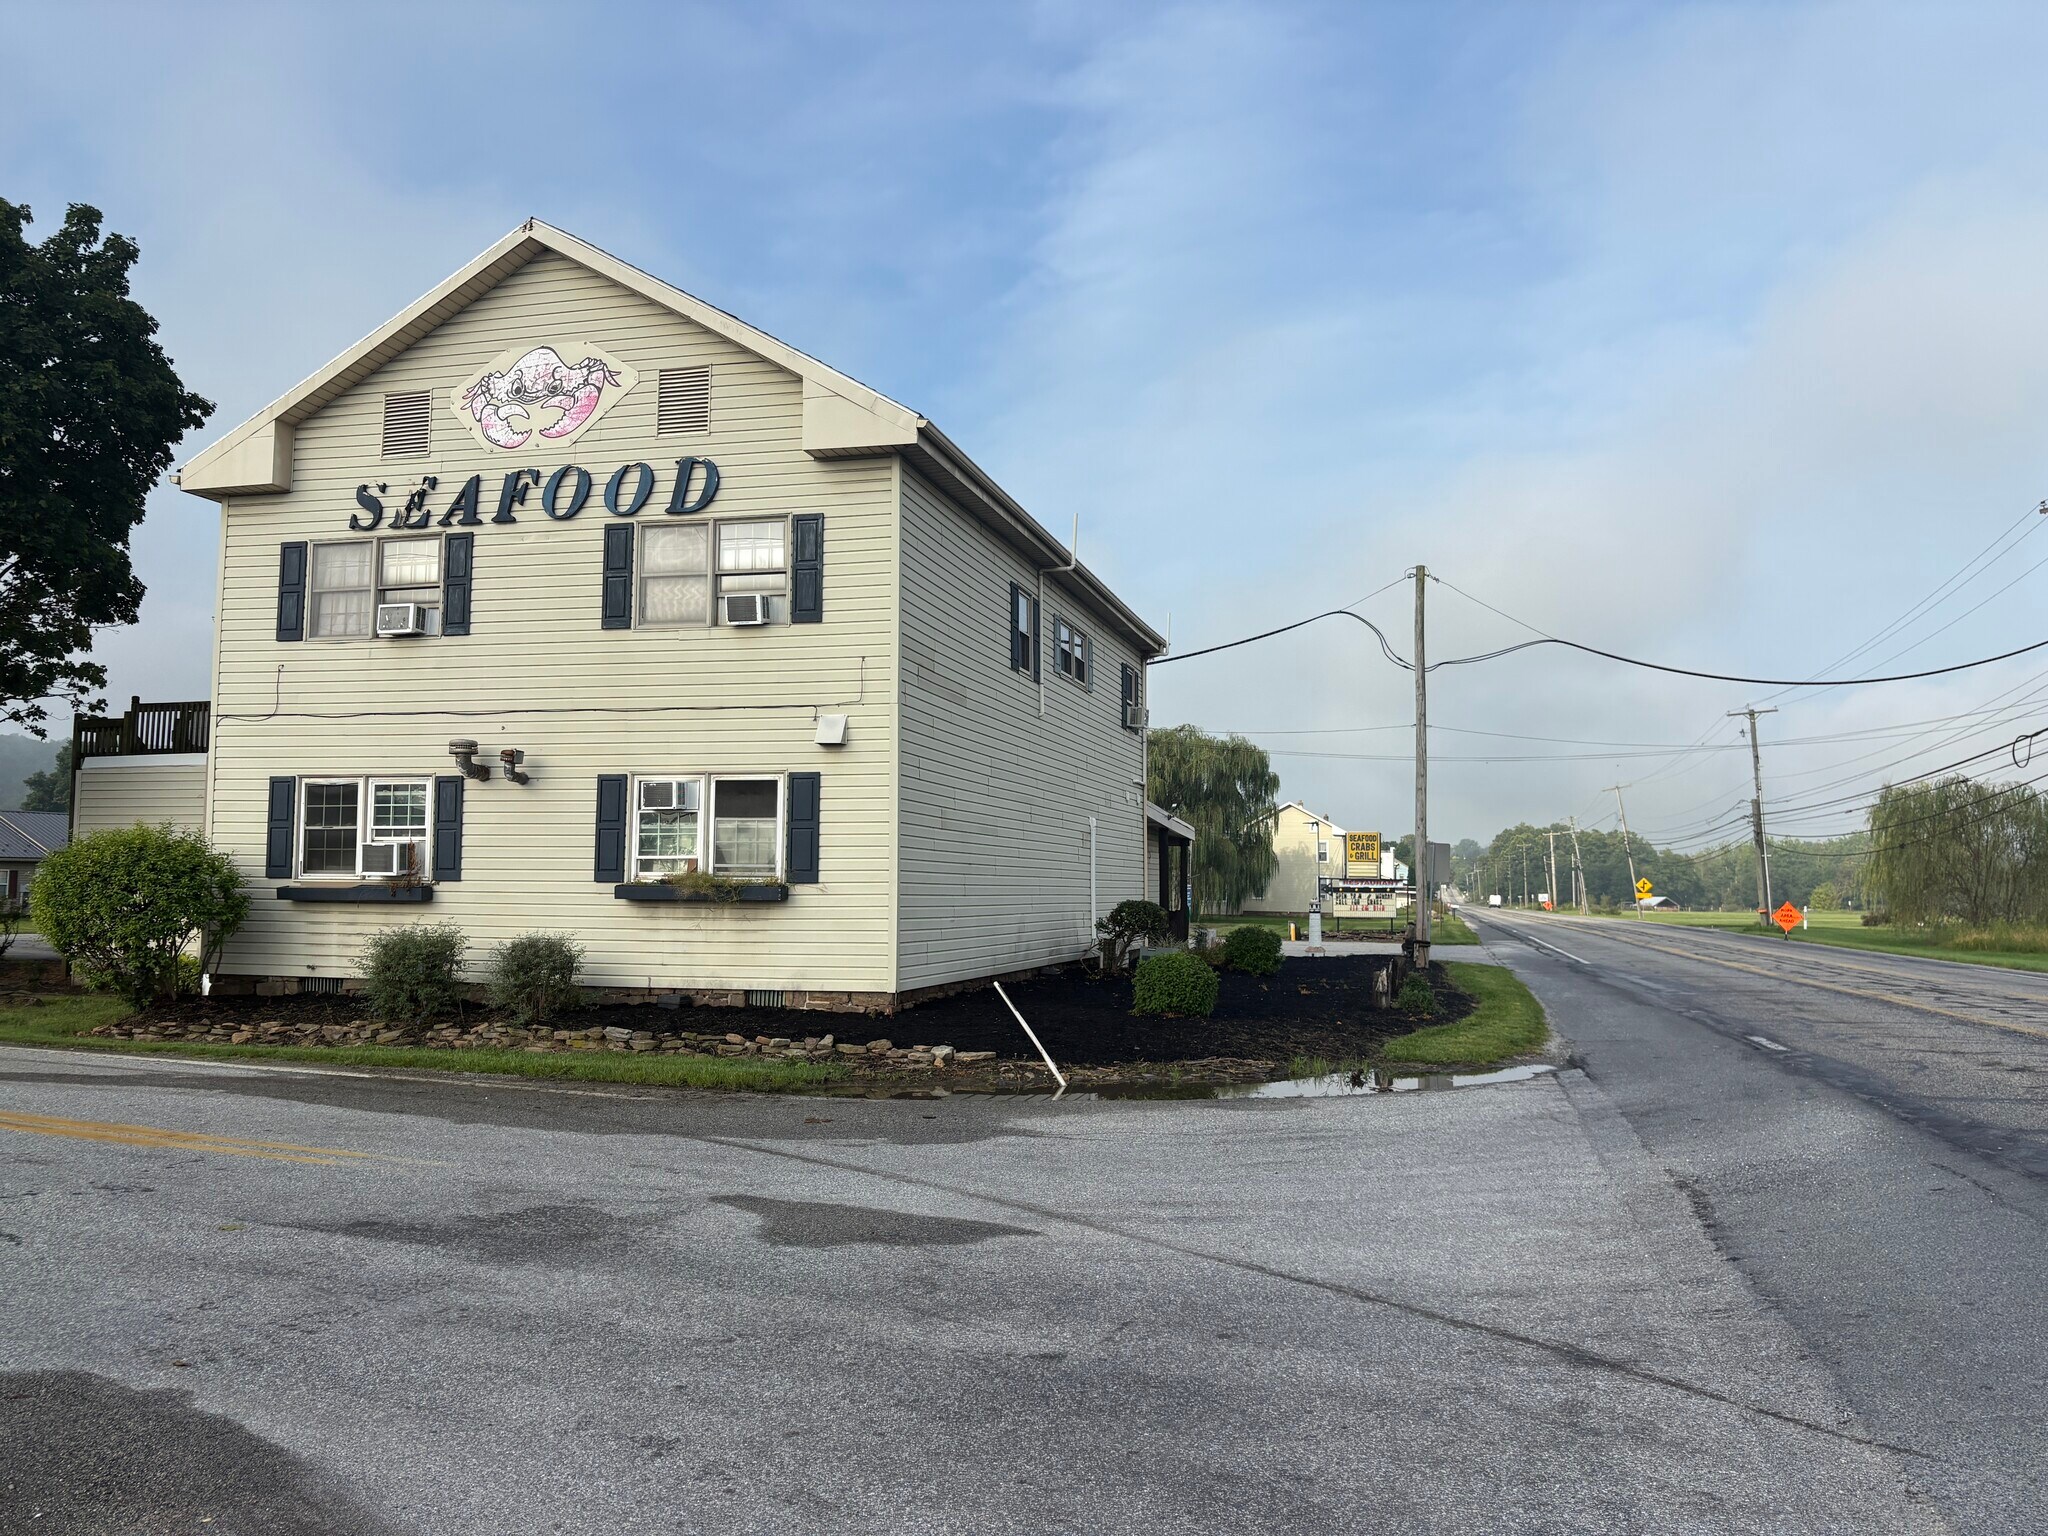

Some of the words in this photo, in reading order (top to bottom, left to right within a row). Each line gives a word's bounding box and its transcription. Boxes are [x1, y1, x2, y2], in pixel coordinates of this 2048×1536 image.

[349, 456, 720, 531] SEAFOOD
[1349, 834, 1376, 842] SEAFOOD
[1351, 842, 1375, 851] CRABS
[1355, 851, 1376, 860] GRILL
